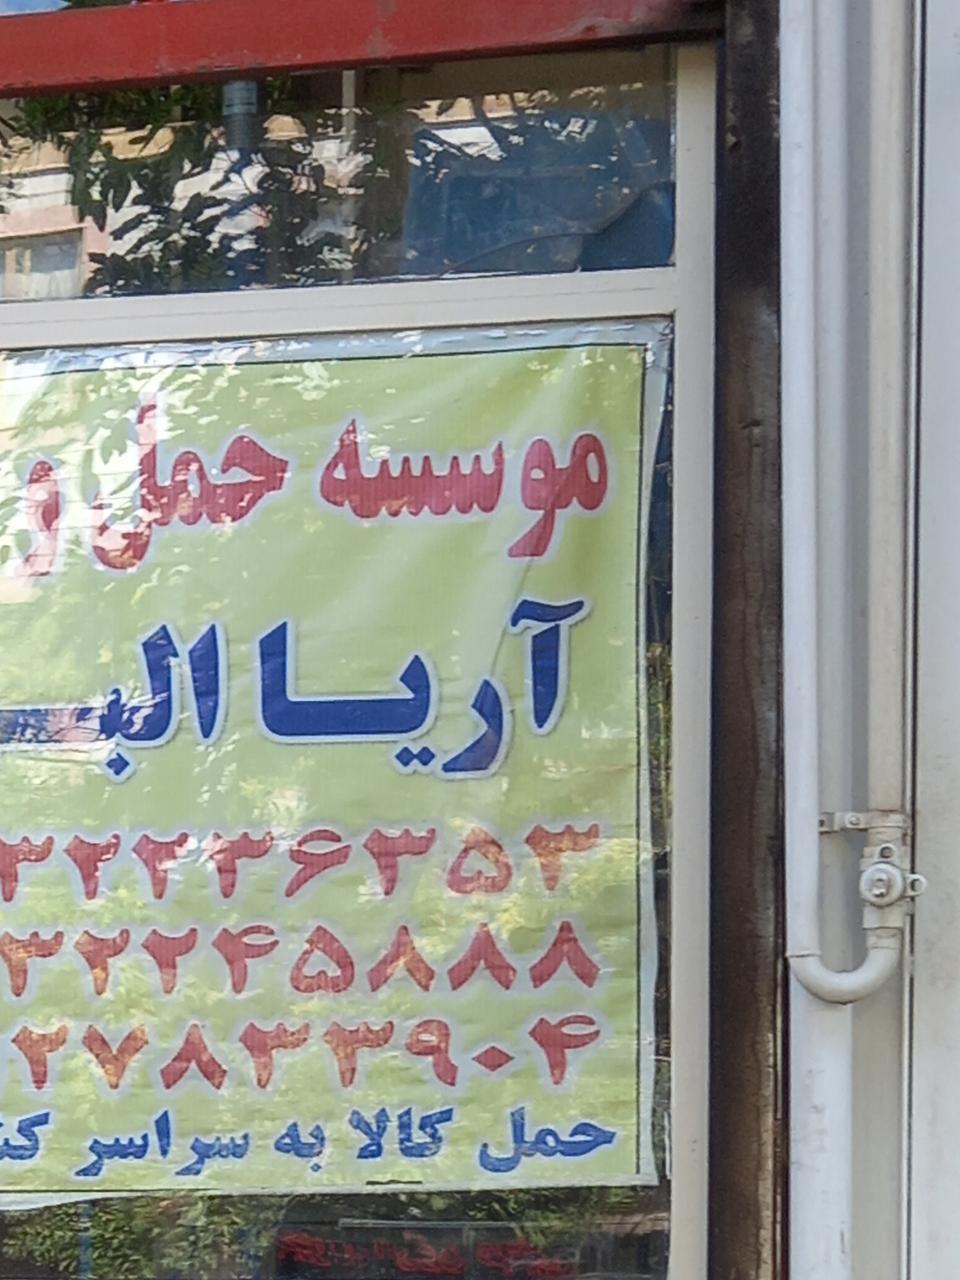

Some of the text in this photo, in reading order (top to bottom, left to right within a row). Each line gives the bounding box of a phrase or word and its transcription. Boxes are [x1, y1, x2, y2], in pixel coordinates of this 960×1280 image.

[16, 460, 60, 576] و
[92, 400, 288, 569] حمل
[320, 419, 608, 557] موسسه
[257, 599, 584, 775] آریا
[74, 1109, 250, 1178] سراسر
[274, 1121, 326, 1173] به
[349, 1106, 455, 1160] کالا
[479, 1106, 617, 1173] حمل
